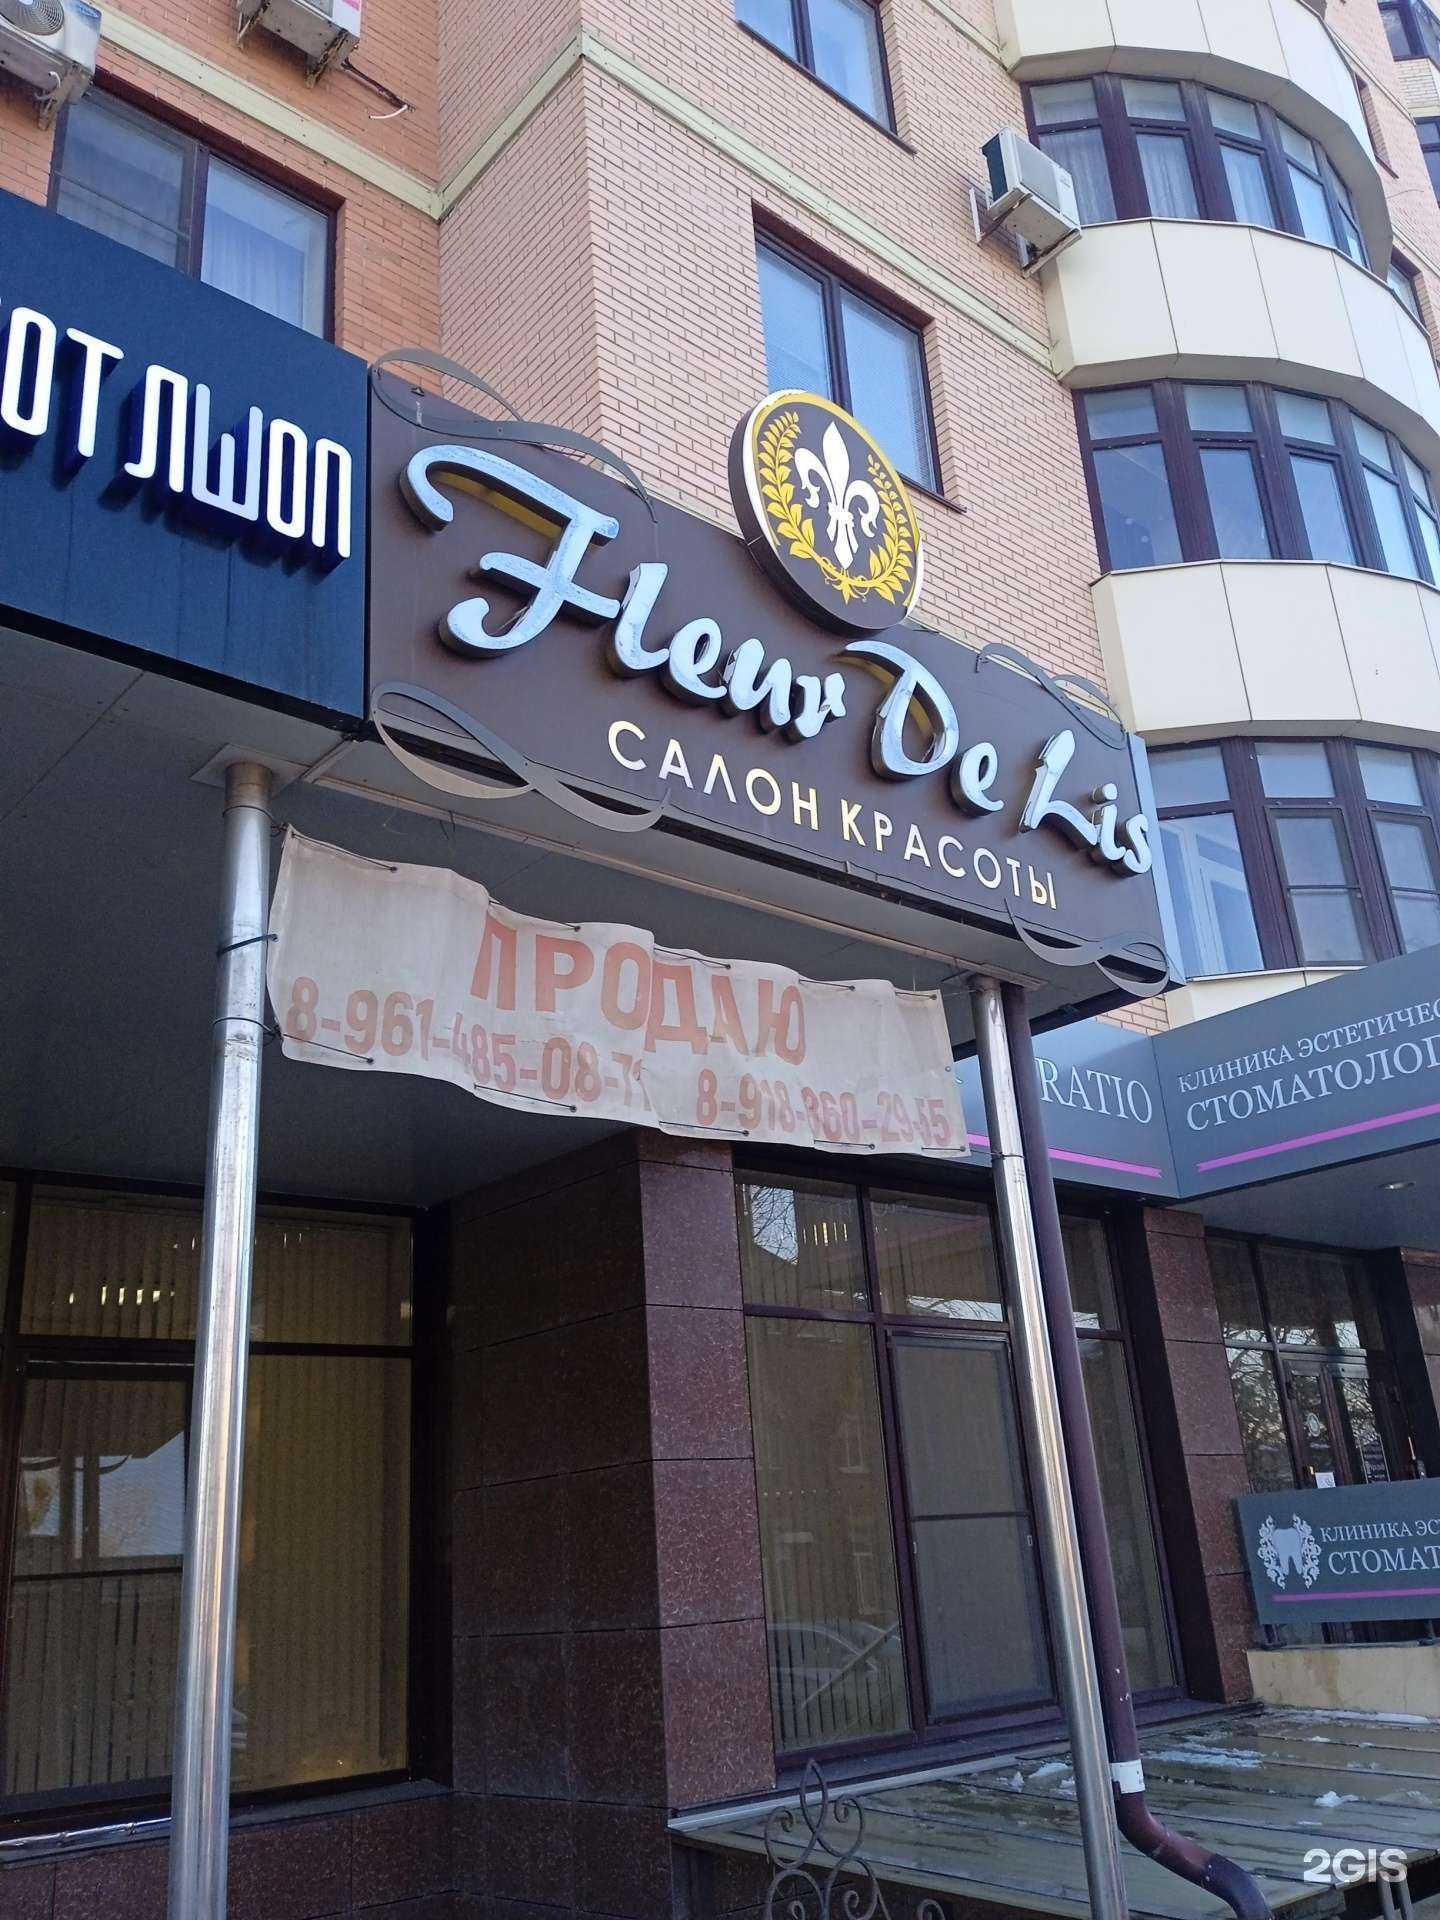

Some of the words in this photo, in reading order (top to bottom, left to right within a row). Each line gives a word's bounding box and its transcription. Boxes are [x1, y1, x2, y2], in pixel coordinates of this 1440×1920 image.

[401, 444, 847, 739] Fleur
[841, 641, 1004, 814] De
[1019, 729, 1153, 876] Lis
[608, 720, 820, 831] САЛОН
[841, 803, 1058, 910] КРАСОТЫ
[469, 914, 807, 1066] ПРОДАЮ
[1179, 1045, 1294, 1093] КЛИНИКА
[1320, 1521, 1413, 1543] КЛИНИКА
[1415, 1519, 1440, 1537] ЭС
